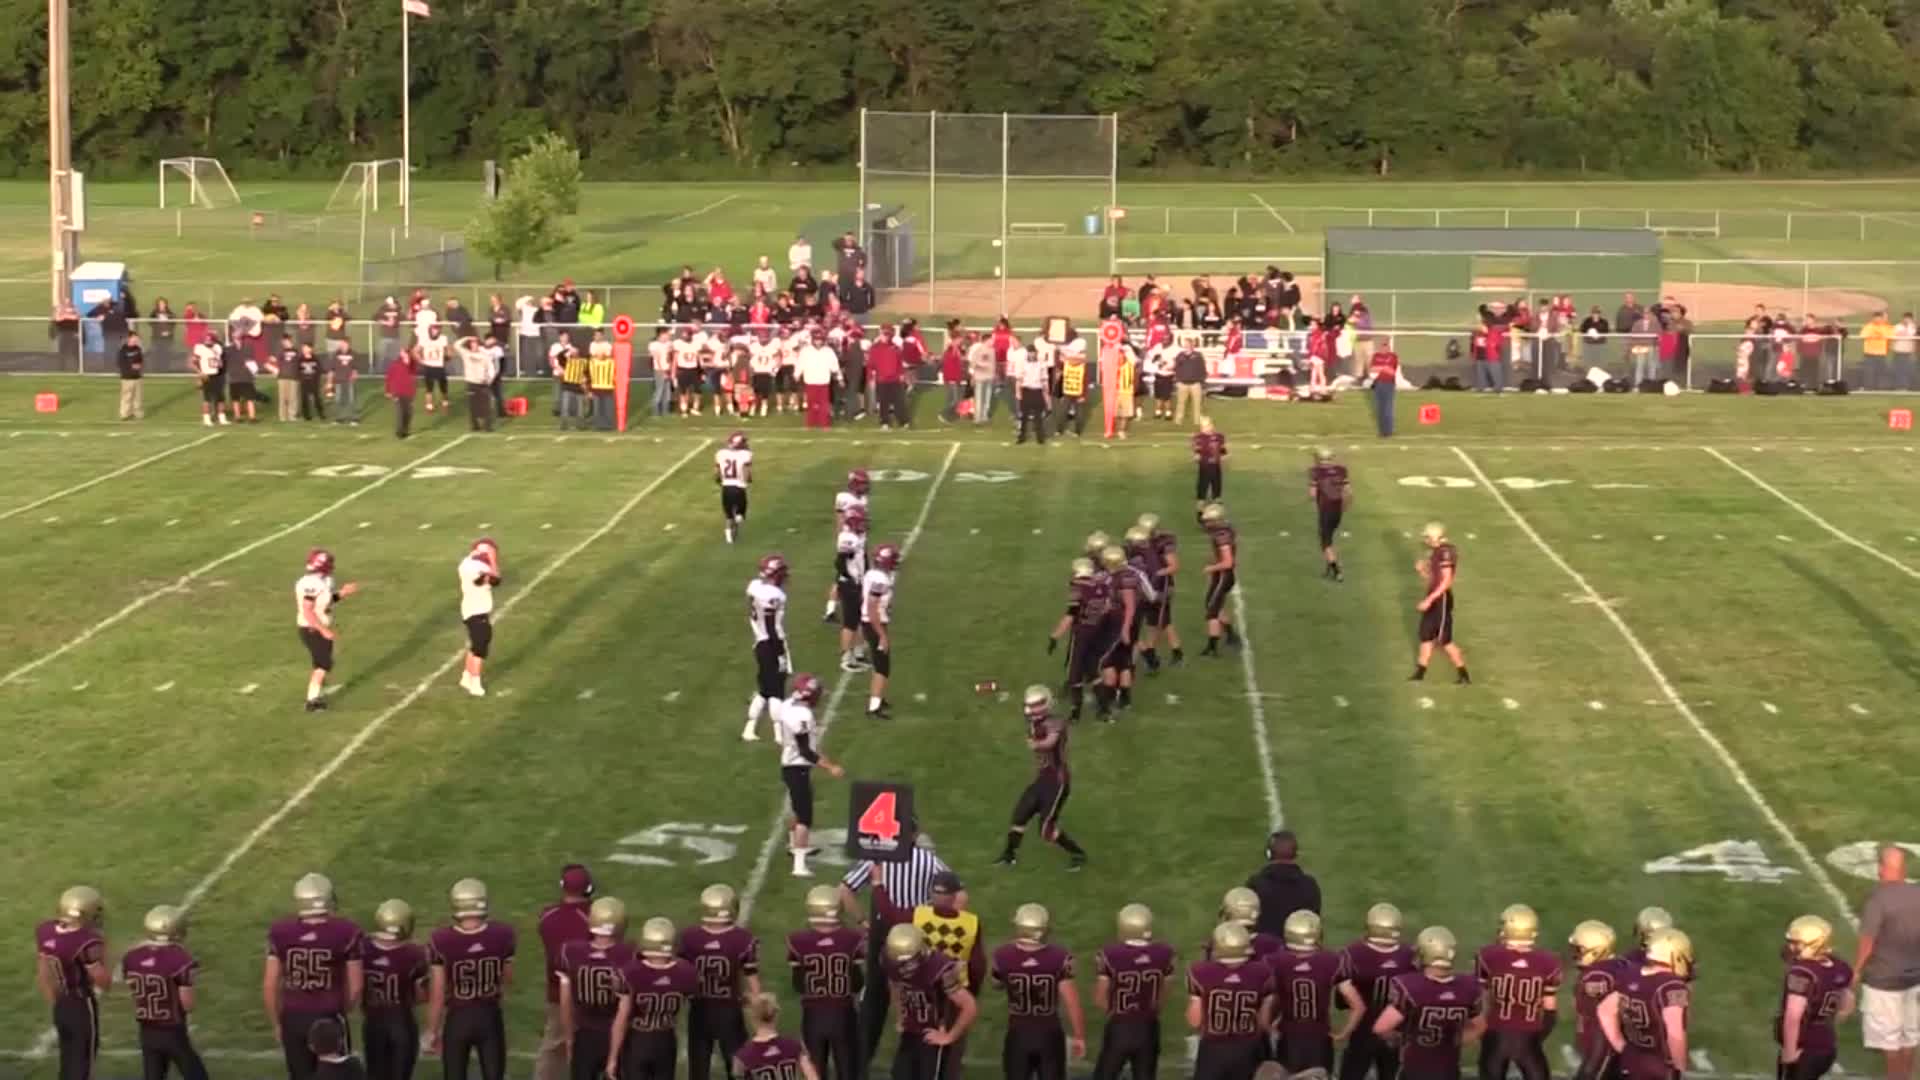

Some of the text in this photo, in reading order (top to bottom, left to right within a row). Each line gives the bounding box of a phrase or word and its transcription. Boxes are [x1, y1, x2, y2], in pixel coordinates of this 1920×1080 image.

[723, 459, 737, 479] 21
[858, 791, 900, 838] 4
[127, 970, 171, 1020] 22
[452, 956, 502, 1000] 60
[577, 964, 615, 1006] 16
[803, 952, 850, 998] 28
[1007, 972, 1055, 1017] 33
[1116, 968, 1164, 1015] 27
[1491, 973, 1543, 1022] 44
[1207, 989, 1258, 1035] 66
[1292, 978, 1317, 1021] 8
